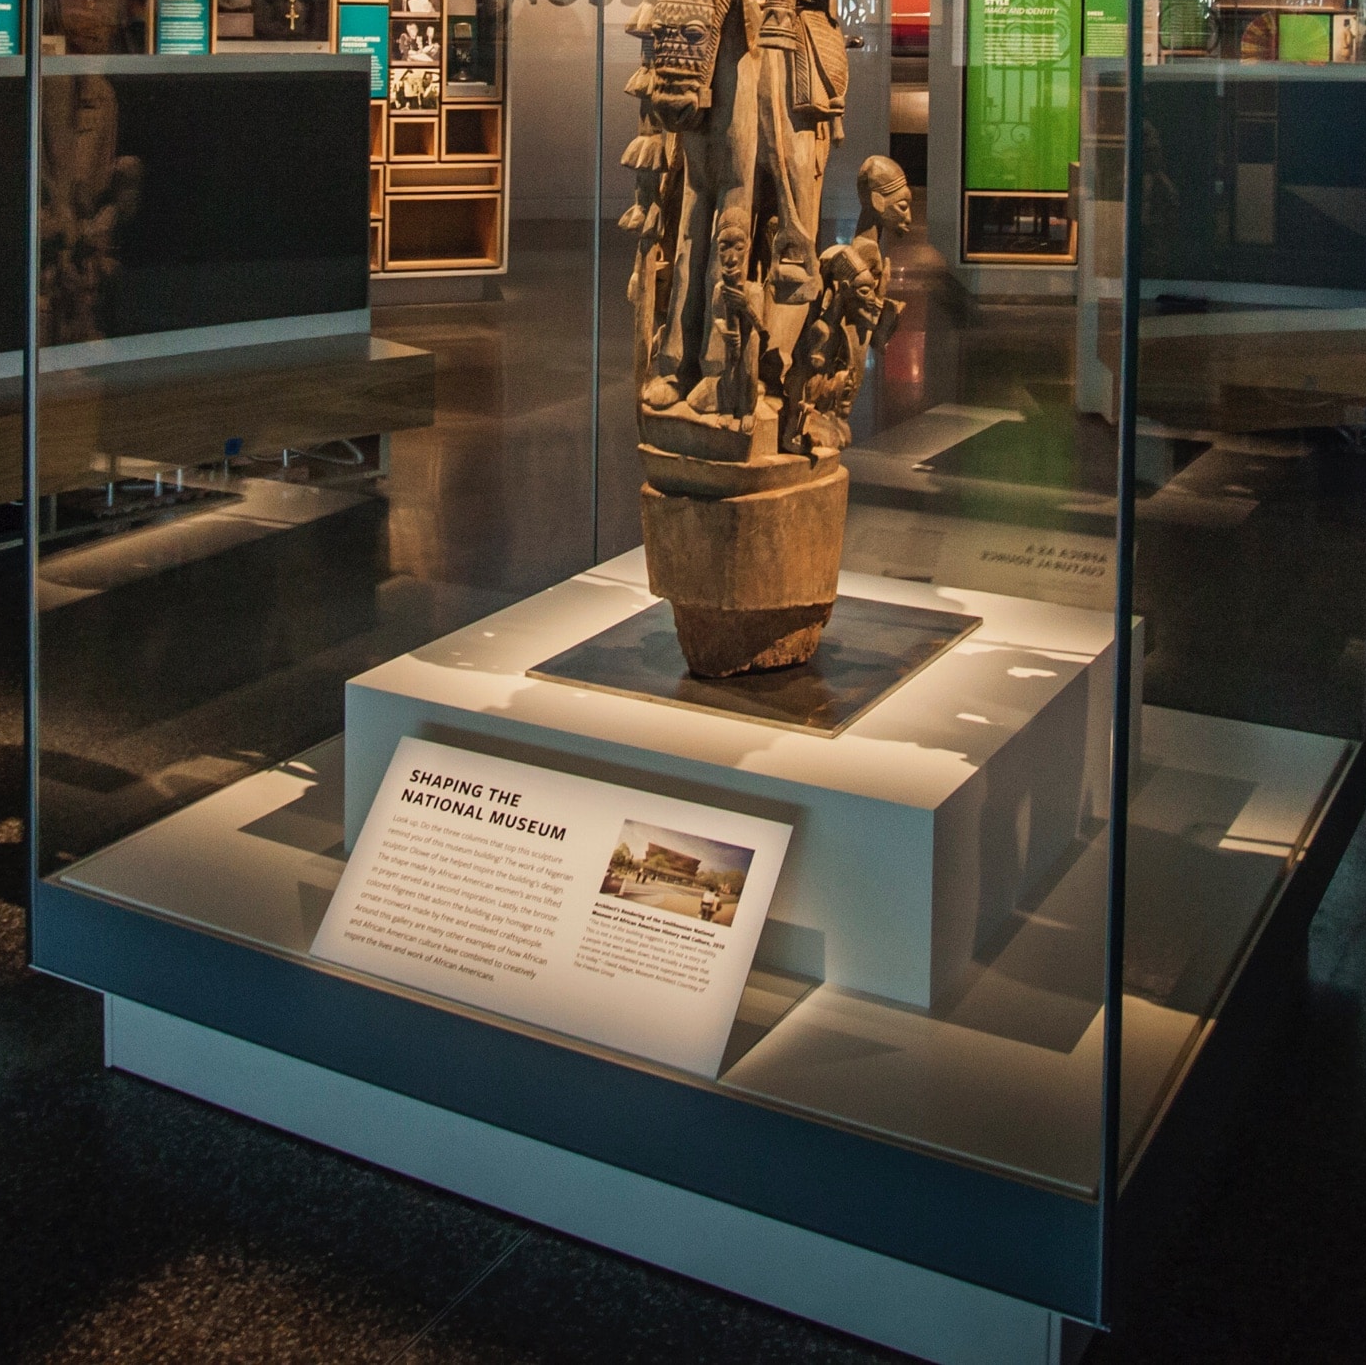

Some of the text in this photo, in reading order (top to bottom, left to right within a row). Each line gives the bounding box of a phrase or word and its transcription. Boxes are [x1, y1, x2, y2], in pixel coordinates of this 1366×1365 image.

[984, 7, 1059, 16] IMAGE AND IDENTITY
[409, 770, 522, 808] SHAPING THE
[401, 789, 566, 841] NATIONAL MUSEUM
[377, 851, 563, 909] The shape made by African American women's arms lifted
[381, 840, 409, 852] sculptor
[429, 852, 440, 860] of
[448, 857, 473, 869] helped
[471, 864, 495, 876] inspire
[494, 870, 508, 879] the
[359, 892, 382, 903] ornate
[382, 898, 411, 911] ironwork
[411, 907, 431, 916] made
[430, 910, 440, 921] by
[439, 913, 455, 923] free
[454, 919, 469, 928] and
[468, 923, 499, 936] enslaved
[365, 879, 392, 891] colored
[416, 892, 431, 902] that
[430, 897, 452, 908] adorn
[451, 902, 464, 911] the
[463, 905, 492, 921] building
[490, 914, 505, 925] pay
[504, 916, 533, 932] homage
[532, 925, 542, 933] to
[542, 928, 555, 937] the
[376, 868, 400, 879] prayer
[399, 874, 423, 885] served
[435, 883, 461, 896] second
[519, 906, 532, 915] the
[343, 931, 494, 982] inspire the lives and work of African Americans.
[348, 918, 537, 980] and African American culture have combined to creatively
[353, 903, 548, 965] Around this gallery are many other examples of how African
